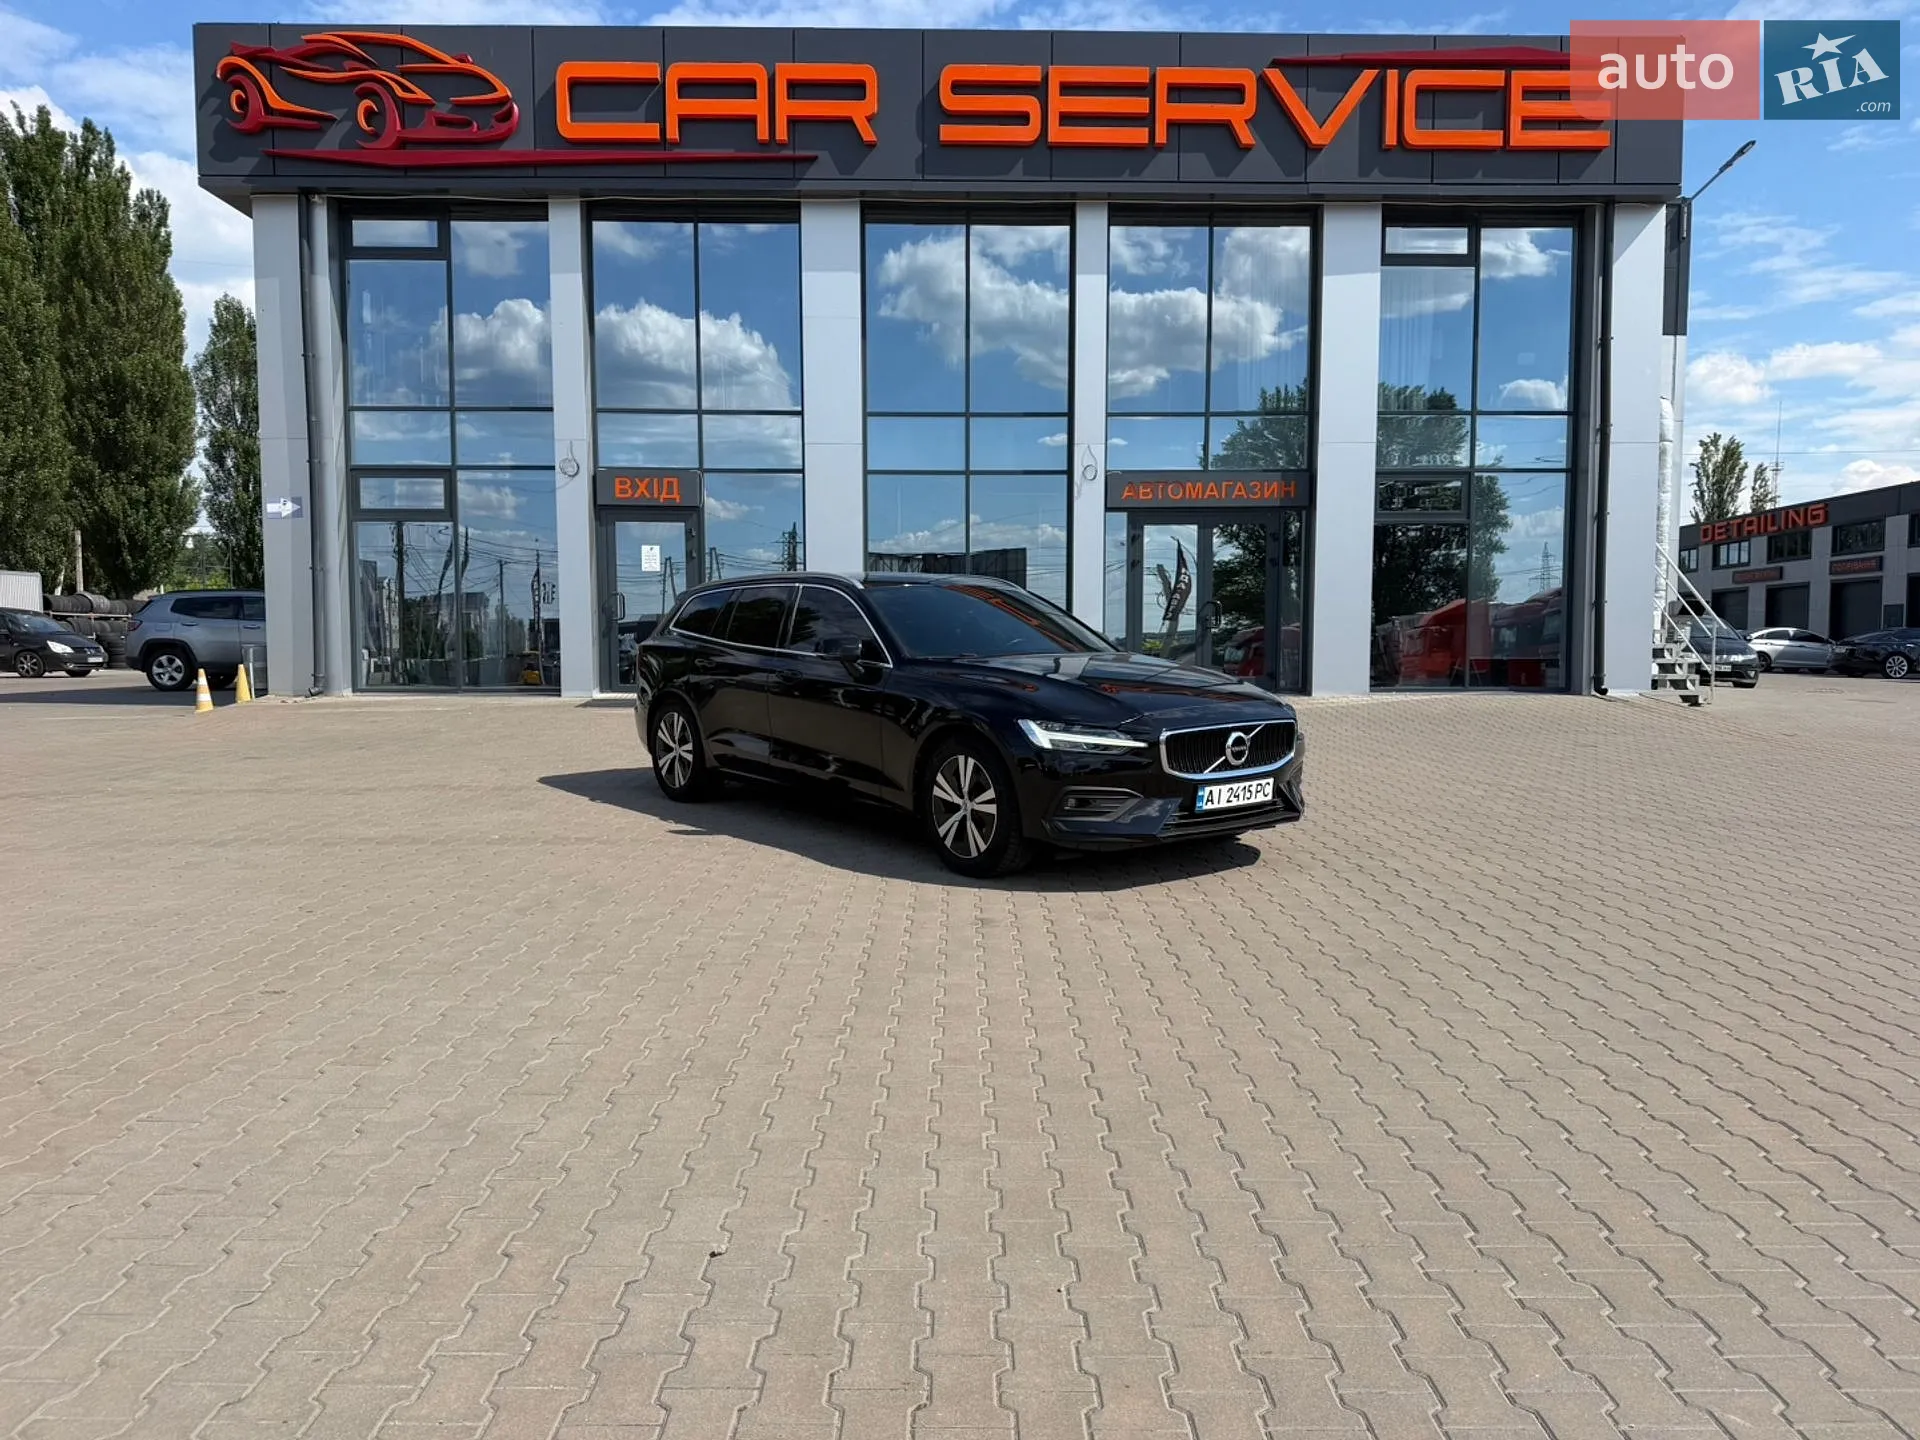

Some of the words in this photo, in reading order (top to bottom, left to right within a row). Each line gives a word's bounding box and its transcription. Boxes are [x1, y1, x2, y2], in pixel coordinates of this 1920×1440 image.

[556, 61, 878, 146] CAR
[939, 63, 1612, 150] SERVICE
[615, 477, 681, 503] ВХІД
[1121, 480, 1297, 501] АВТОМАГАЗИН
[1701, 503, 1827, 541] DETAILING
[1205, 788, 1222, 806] AI
[1226, 784, 1253, 804] 2415
[1254, 781, 1271, 800] PC
